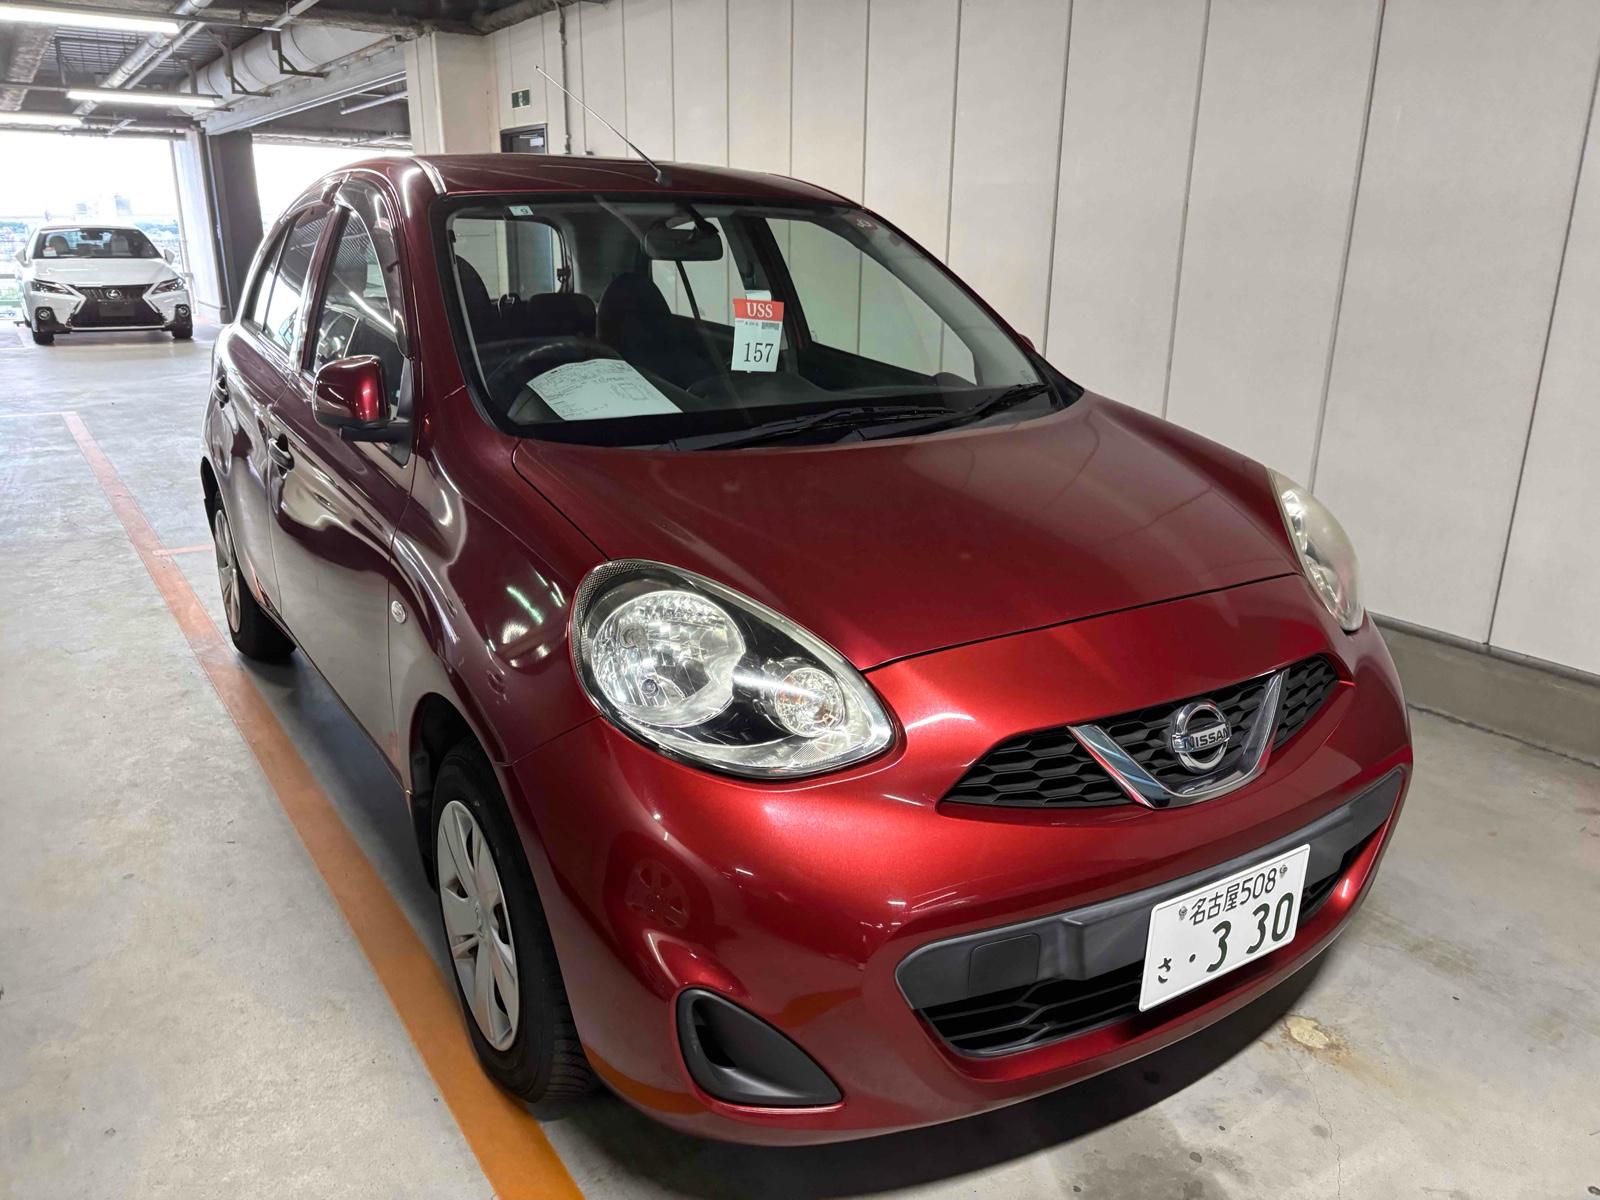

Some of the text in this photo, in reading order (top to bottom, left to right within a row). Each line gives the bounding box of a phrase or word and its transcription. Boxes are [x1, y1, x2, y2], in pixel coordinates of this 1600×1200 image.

[746, 302, 773, 318] USS
[743, 342, 774, 363] 157
[1184, 726, 1229, 749] NISSAN
